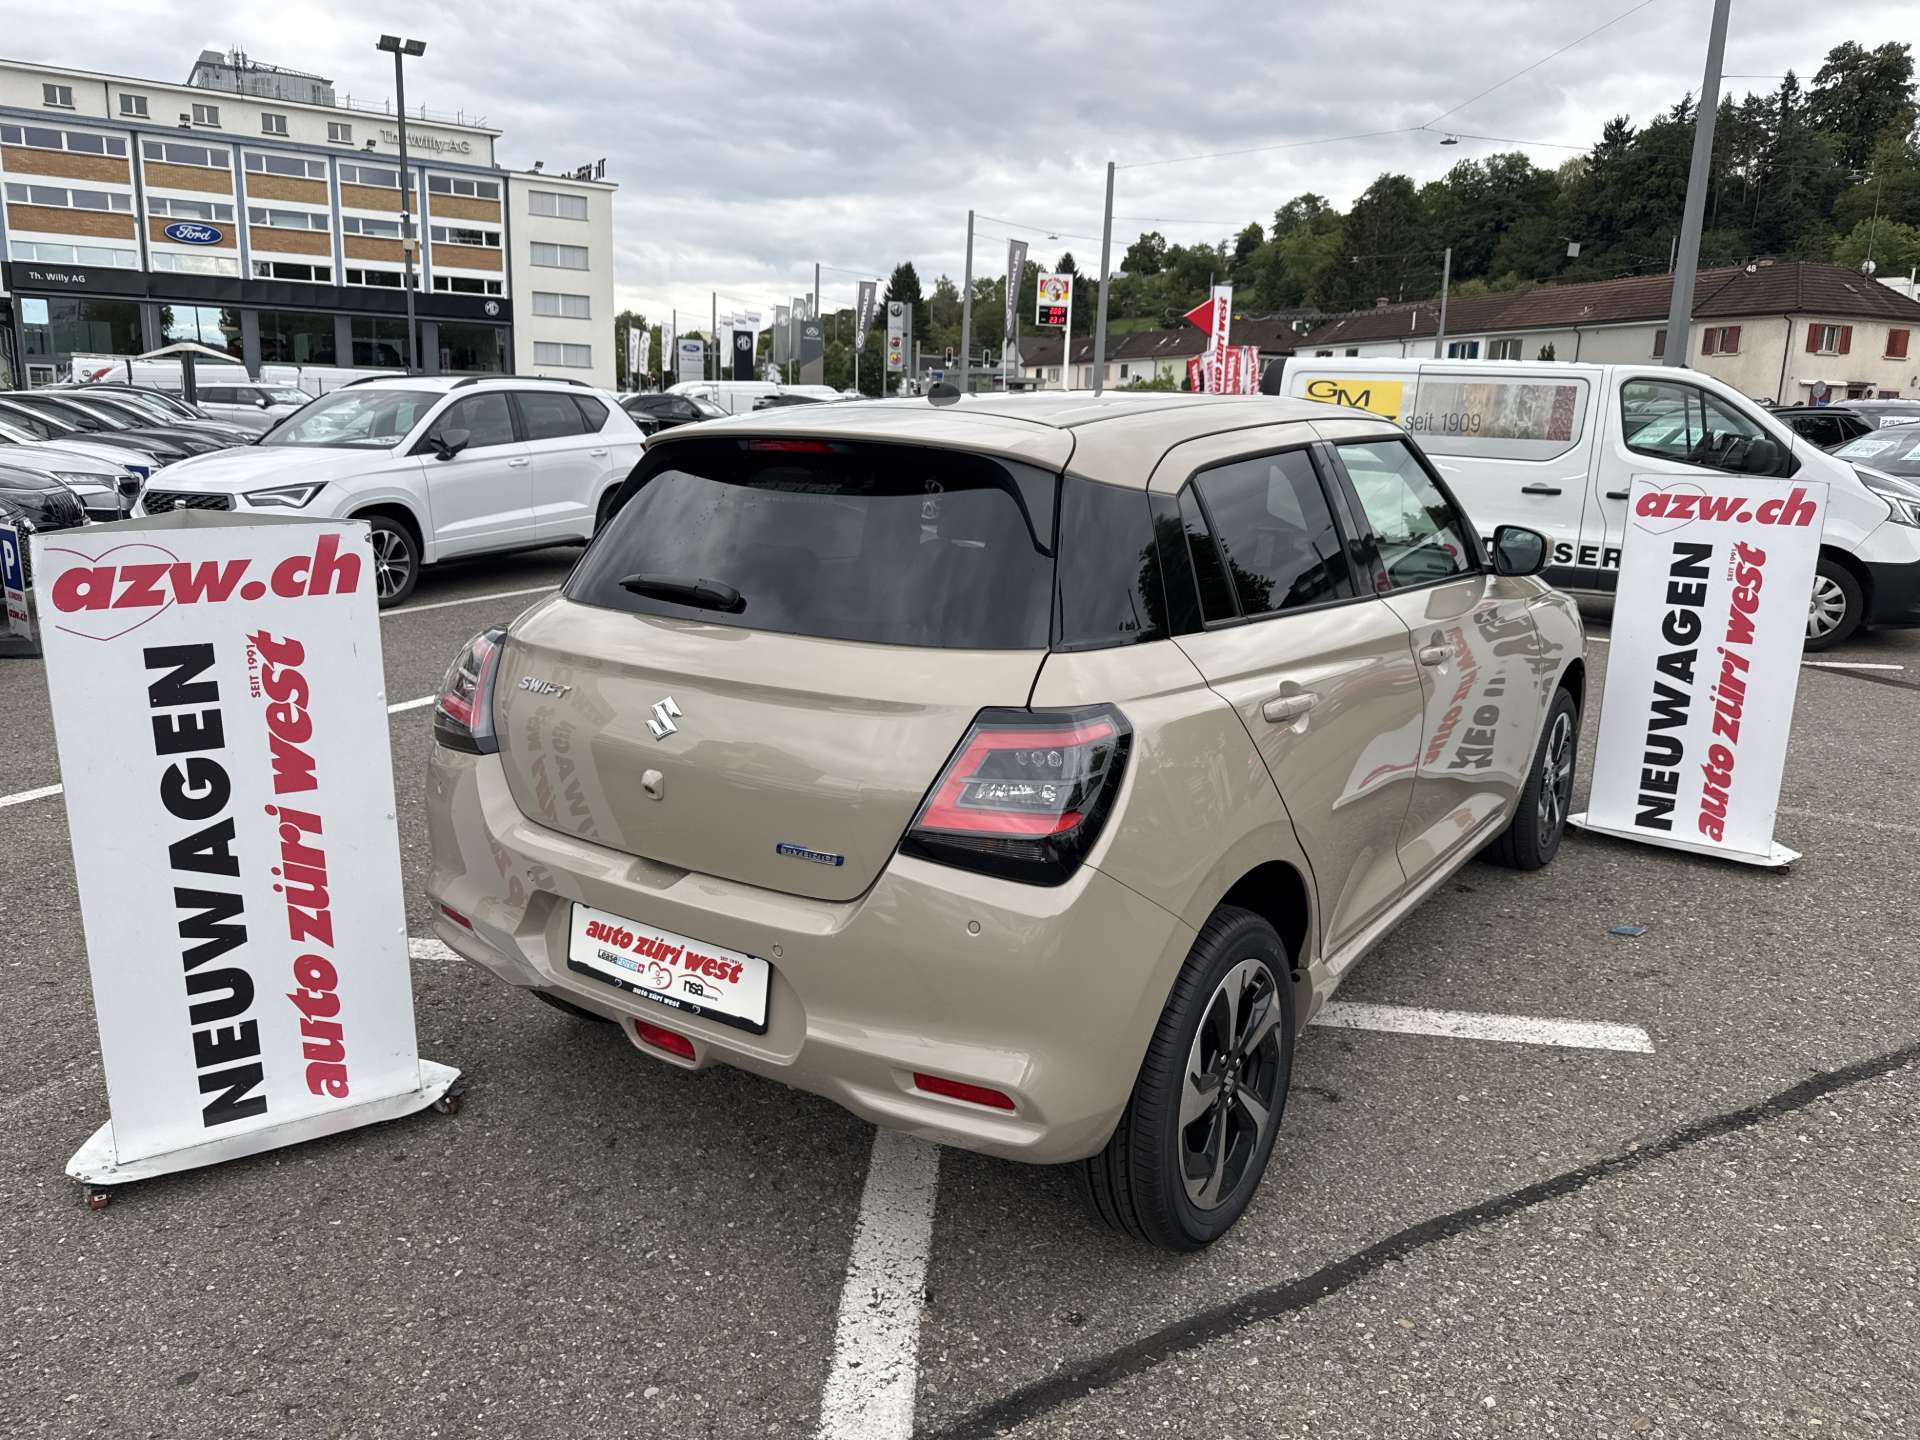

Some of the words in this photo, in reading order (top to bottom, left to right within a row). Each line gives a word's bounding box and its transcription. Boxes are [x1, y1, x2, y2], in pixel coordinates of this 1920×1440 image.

[408, 133, 443, 152] Willy
[449, 140, 473, 154] AG
[176, 225, 211, 241] Ford
[29, 271, 44, 280] Th.
[45, 272, 69, 284] Willy
[71, 274, 86, 283] AG
[1307, 380, 1371, 407] GM
[1404, 412, 1434, 432] seit
[1440, 413, 1482, 433] 1909
[1635, 487, 1817, 528] azw.ch
[51, 534, 362, 613] azw.ch
[1725, 541, 1767, 645] west
[246, 644, 258, 671] 1991
[250, 676, 261, 698] SEIT
[518, 676, 572, 698] SWIFT
[1634, 541, 1714, 831] NEUWAGEN
[1708, 646, 1750, 745] züri
[245, 630, 319, 795] west
[1697, 743, 1735, 842] auto
[142, 643, 268, 1128] NEUWAGEN
[264, 803, 334, 948] züri
[585, 920, 634, 949] auto
[632, 936, 686, 966] züri
[685, 950, 744, 984] west
[632, 986, 649, 997] auto
[648, 991, 664, 1003] züri
[664, 997, 681, 1008] west
[683, 979, 704, 997] nsa
[286, 954, 349, 1099] auto
